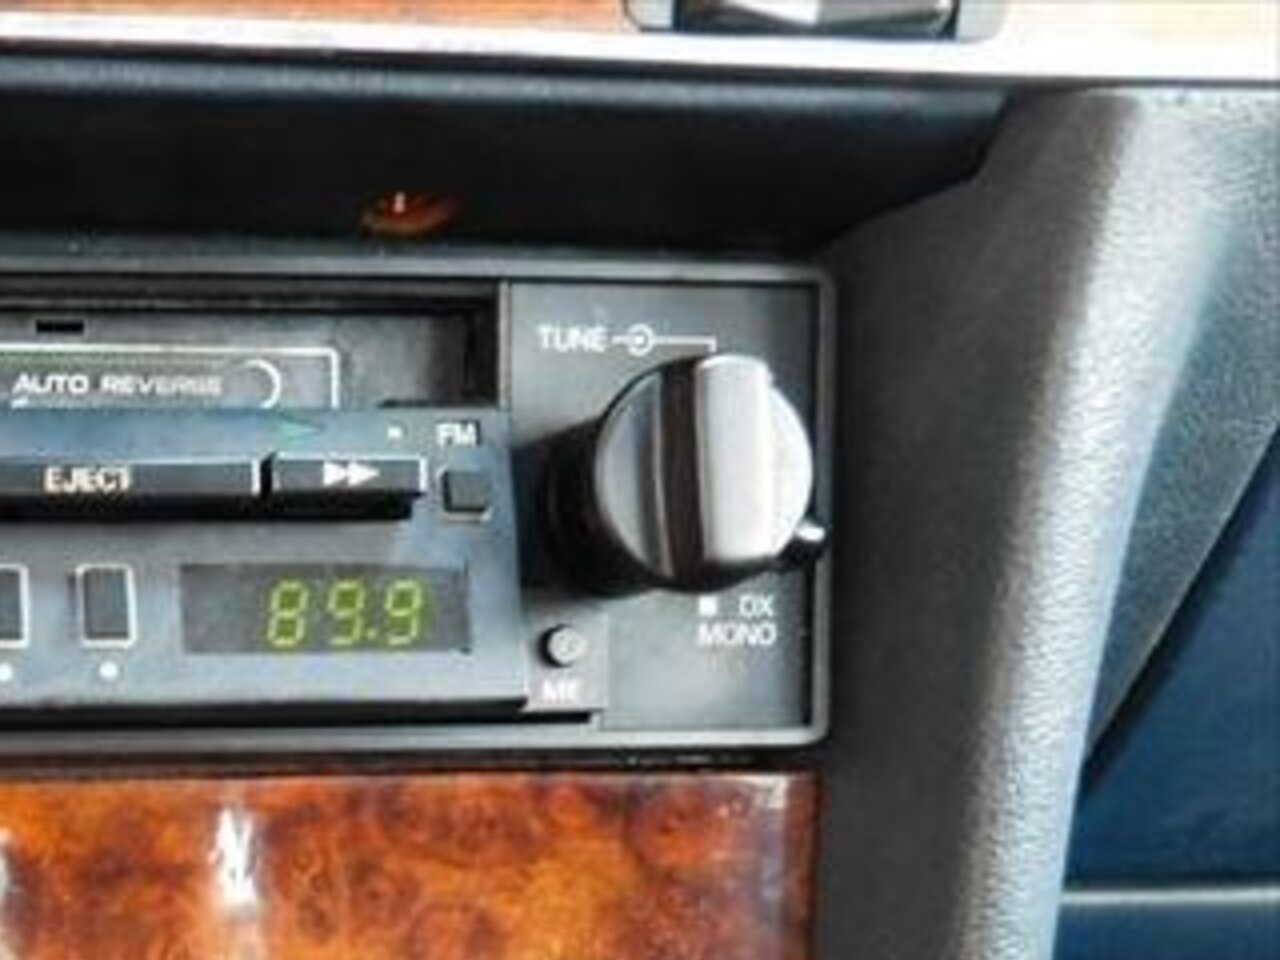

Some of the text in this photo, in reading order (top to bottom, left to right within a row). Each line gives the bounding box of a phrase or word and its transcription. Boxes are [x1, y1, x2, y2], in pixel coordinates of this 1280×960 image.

[538, 324, 611, 353] TUNE
[11, 371, 89, 395] AUTO
[437, 423, 477, 446] FM
[43, 465, 131, 495] EJECT
[698, 621, 778, 645] MONO
